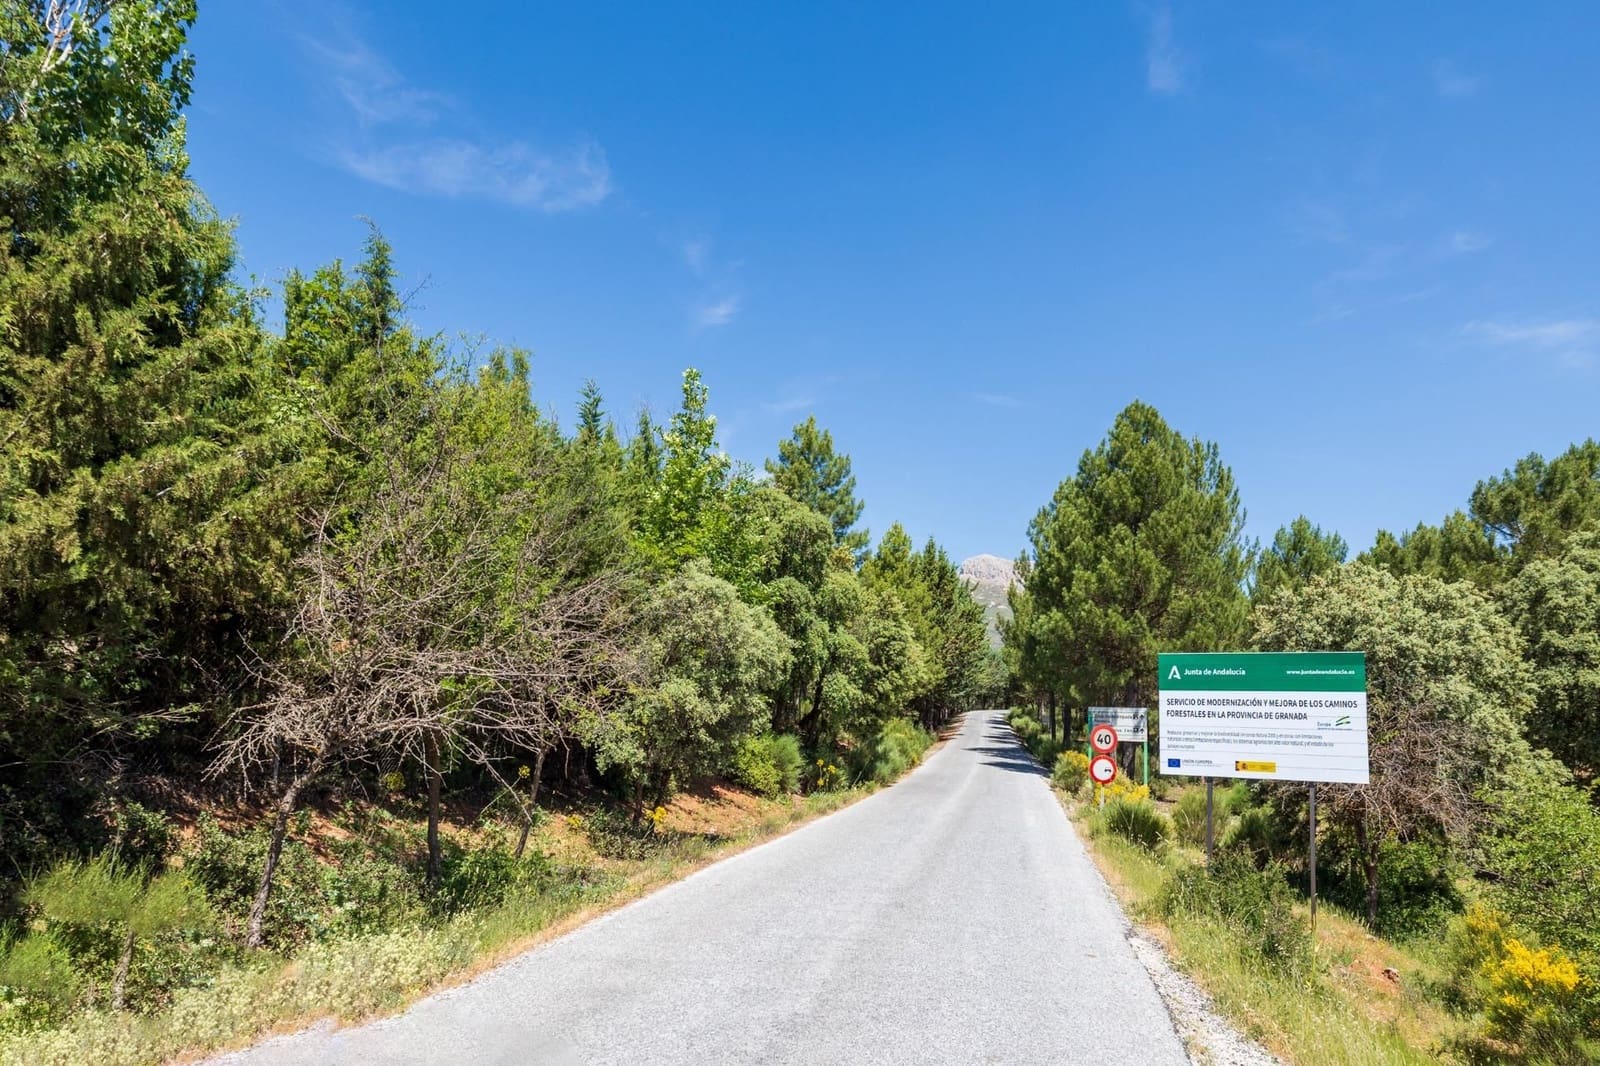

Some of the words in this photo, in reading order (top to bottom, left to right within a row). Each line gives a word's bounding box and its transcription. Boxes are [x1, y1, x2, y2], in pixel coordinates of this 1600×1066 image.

[1183, 667, 1202, 676] Junta
[1203, 667, 1212, 675] de
[1213, 667, 1246, 675] Andalucía
[1166, 698, 1196, 706] SERVICIO
[1197, 698, 1205, 706] DE
[1206, 697, 1262, 707] MODERNIZACIÓN
[1263, 699, 1268, 707] Y
[1269, 699, 1297, 707] MEJORA
[1298, 700, 1307, 708] DE
[1309, 700, 1323, 708] LOS
[1324, 700, 1358, 708] CAMINOS
[1166, 710, 1206, 718] FORESTALES
[1227, 711, 1263, 719] PROVINCIA
[1274, 712, 1308, 720] GRANADA
[1097, 734, 1111, 744] 40
